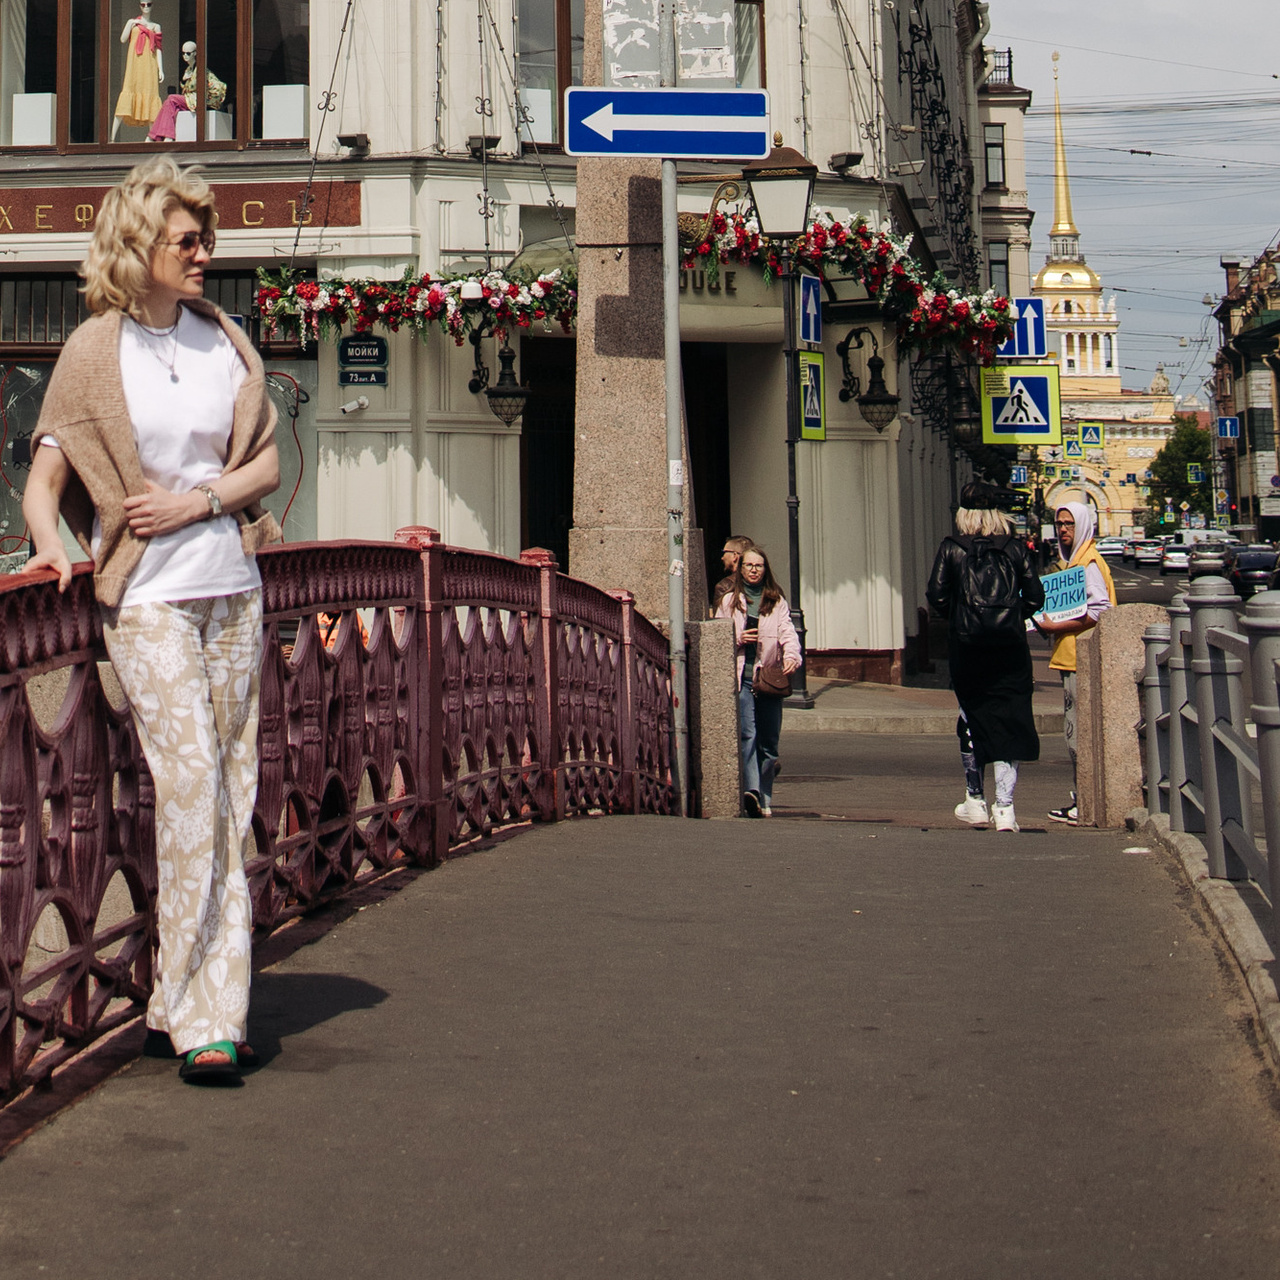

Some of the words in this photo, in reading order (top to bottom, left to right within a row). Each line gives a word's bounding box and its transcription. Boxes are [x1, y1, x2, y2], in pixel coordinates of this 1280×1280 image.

[347, 345, 379, 356] МОЙКИ
[349, 373, 359, 382] 73
[1043, 570, 1085, 593] ОДНЫЕ
[1040, 587, 1085, 612] ГУЛКИ
